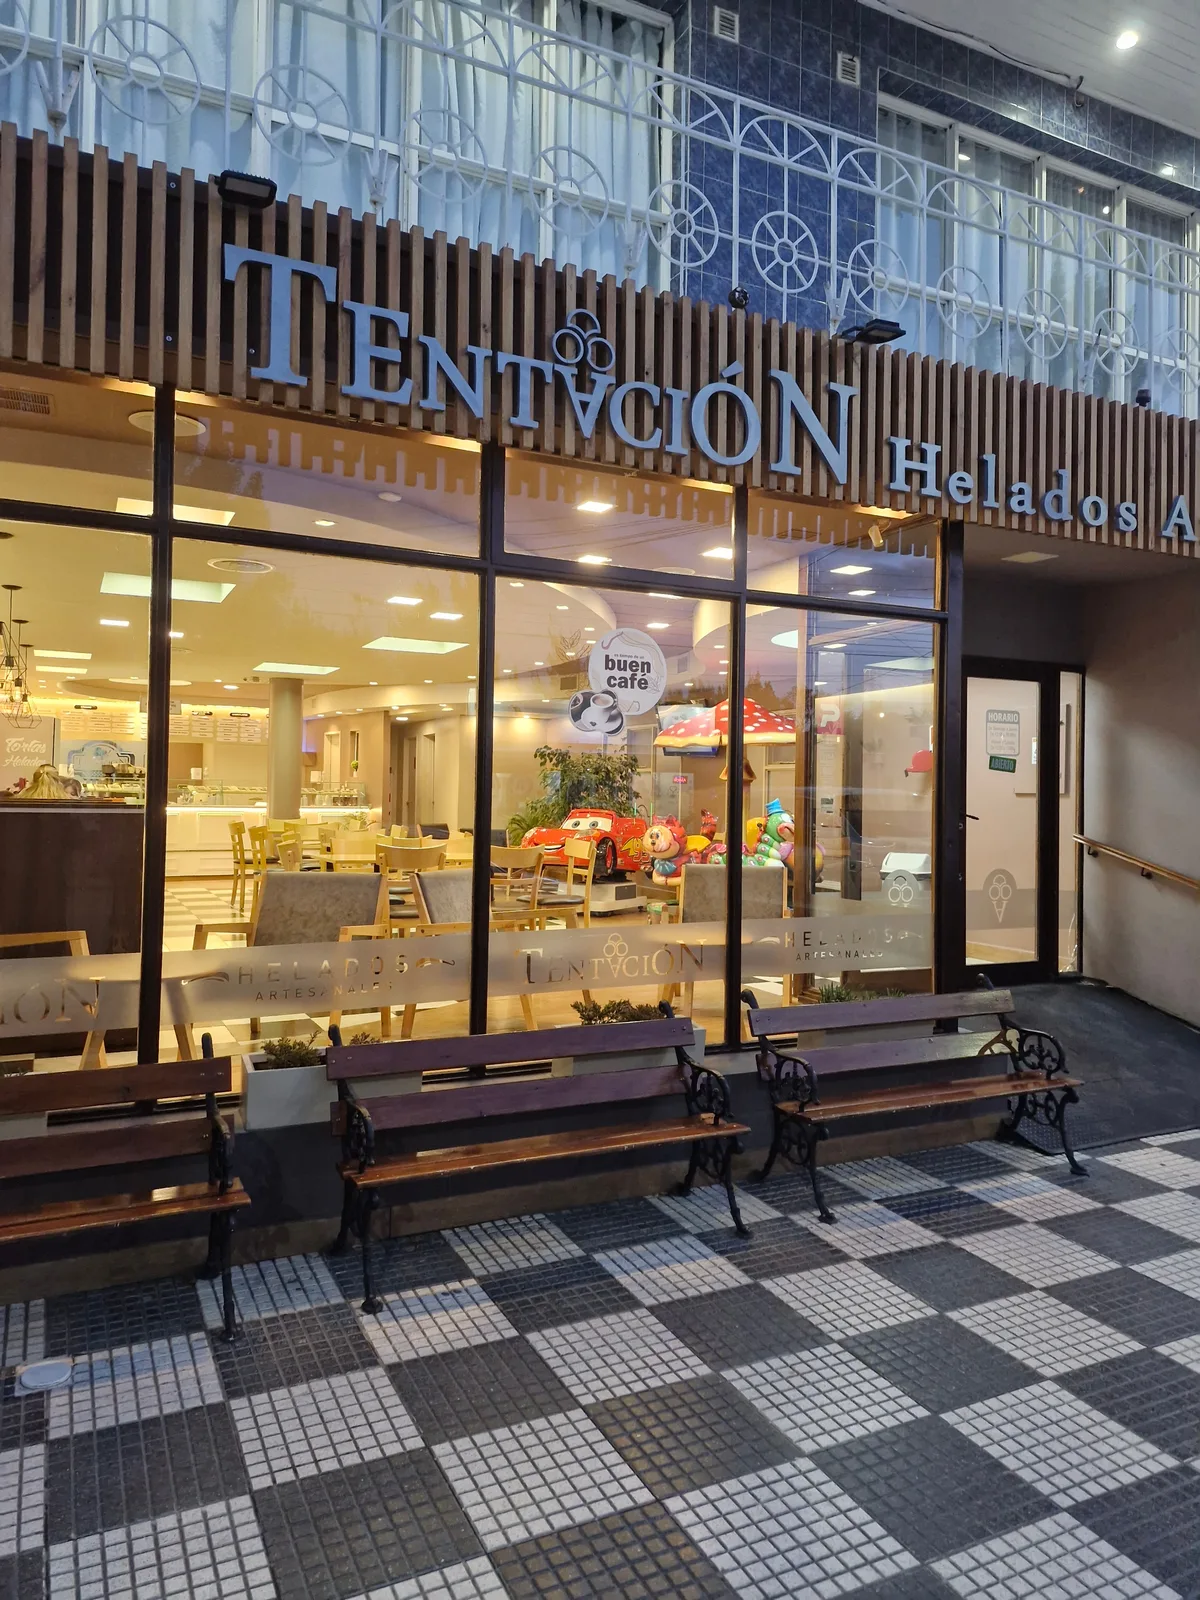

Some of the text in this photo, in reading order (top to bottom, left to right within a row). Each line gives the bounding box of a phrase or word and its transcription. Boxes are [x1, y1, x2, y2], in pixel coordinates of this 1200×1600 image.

[224, 243, 1198, 541] TENTACIÓN Helados A
[604, 654, 651, 673] buen
[606, 673, 649, 690] café
[988, 712, 1018, 723] HORARIO
[5, 737, 46, 753] Tortas
[990, 758, 1014, 771] ABIERTO
[238, 954, 409, 985] HELADOS
